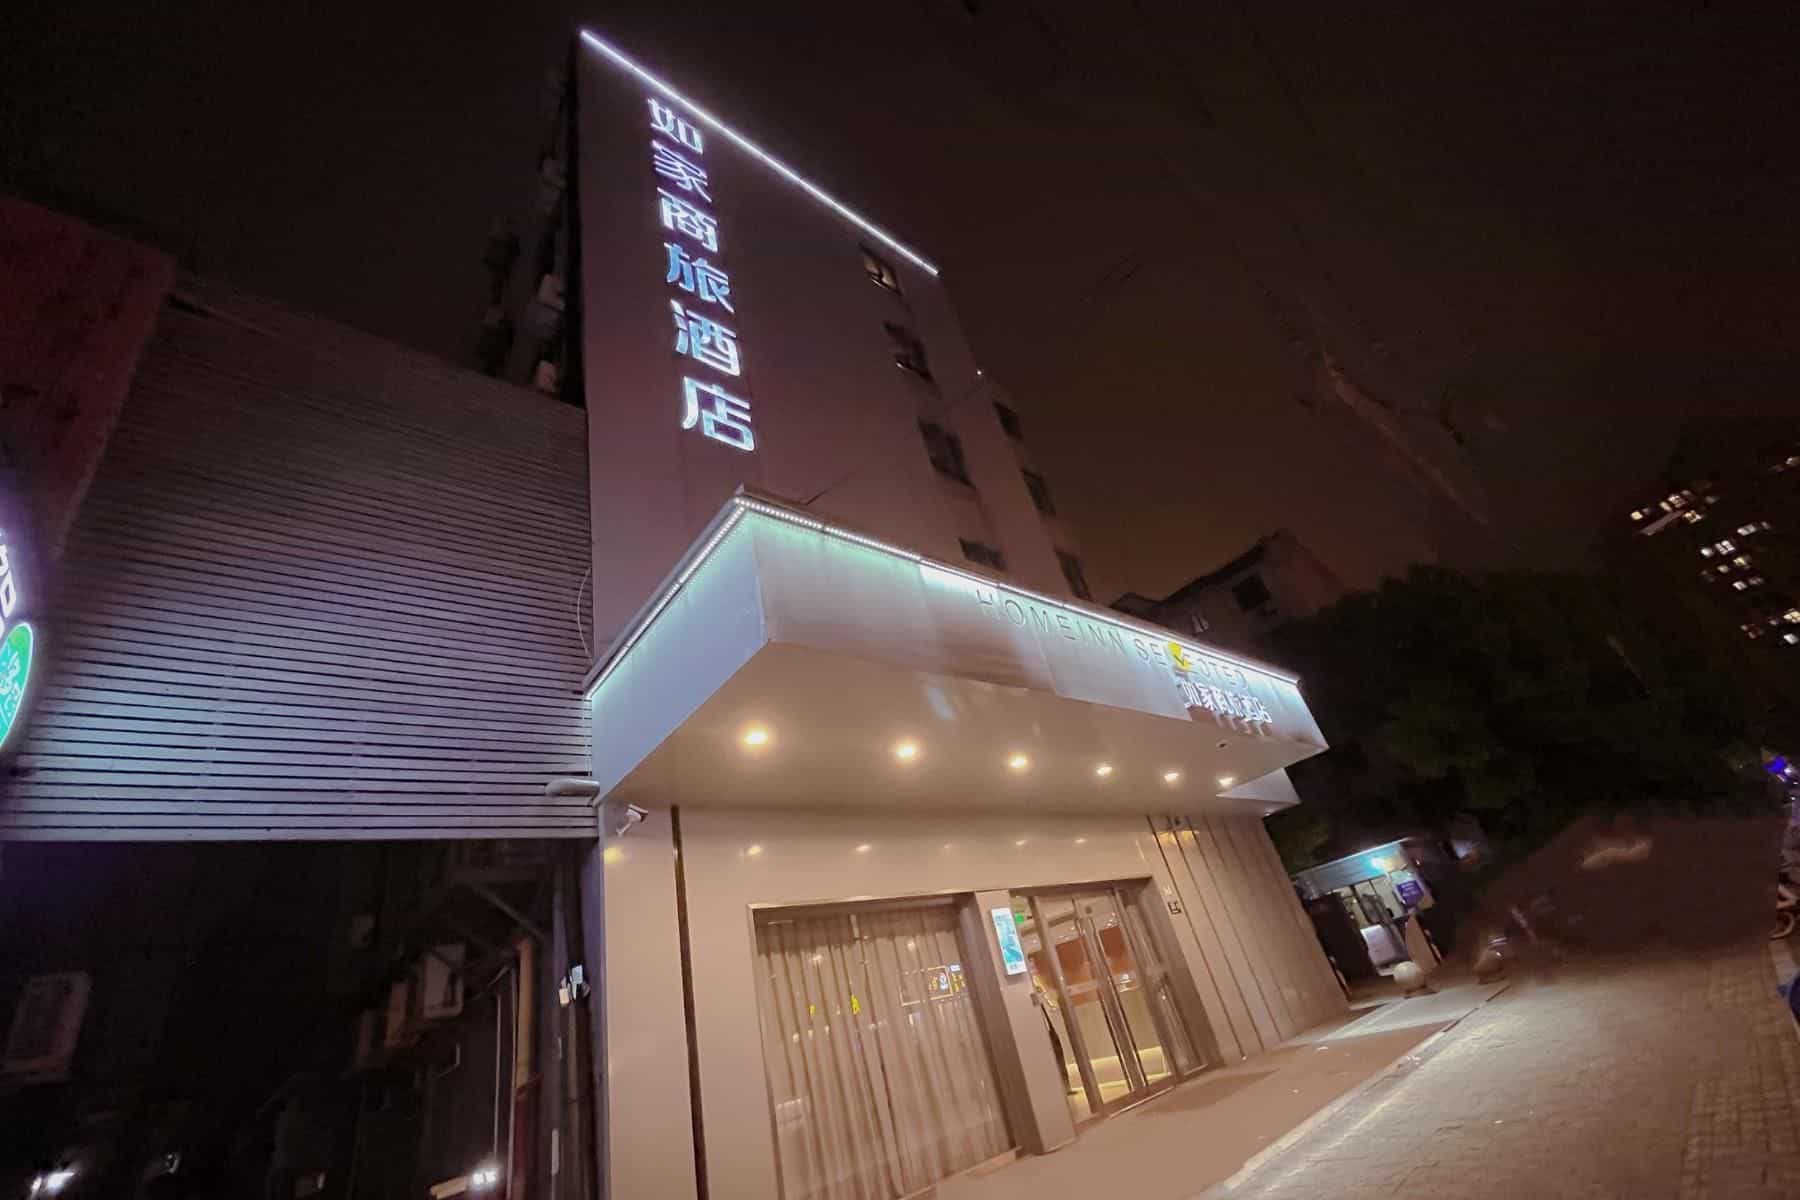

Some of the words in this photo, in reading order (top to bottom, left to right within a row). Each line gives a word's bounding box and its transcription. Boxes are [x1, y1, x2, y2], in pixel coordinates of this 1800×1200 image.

[647, 97, 755, 451] 如家商旅酒店
[976, 588, 1128, 654] HOMEINN
